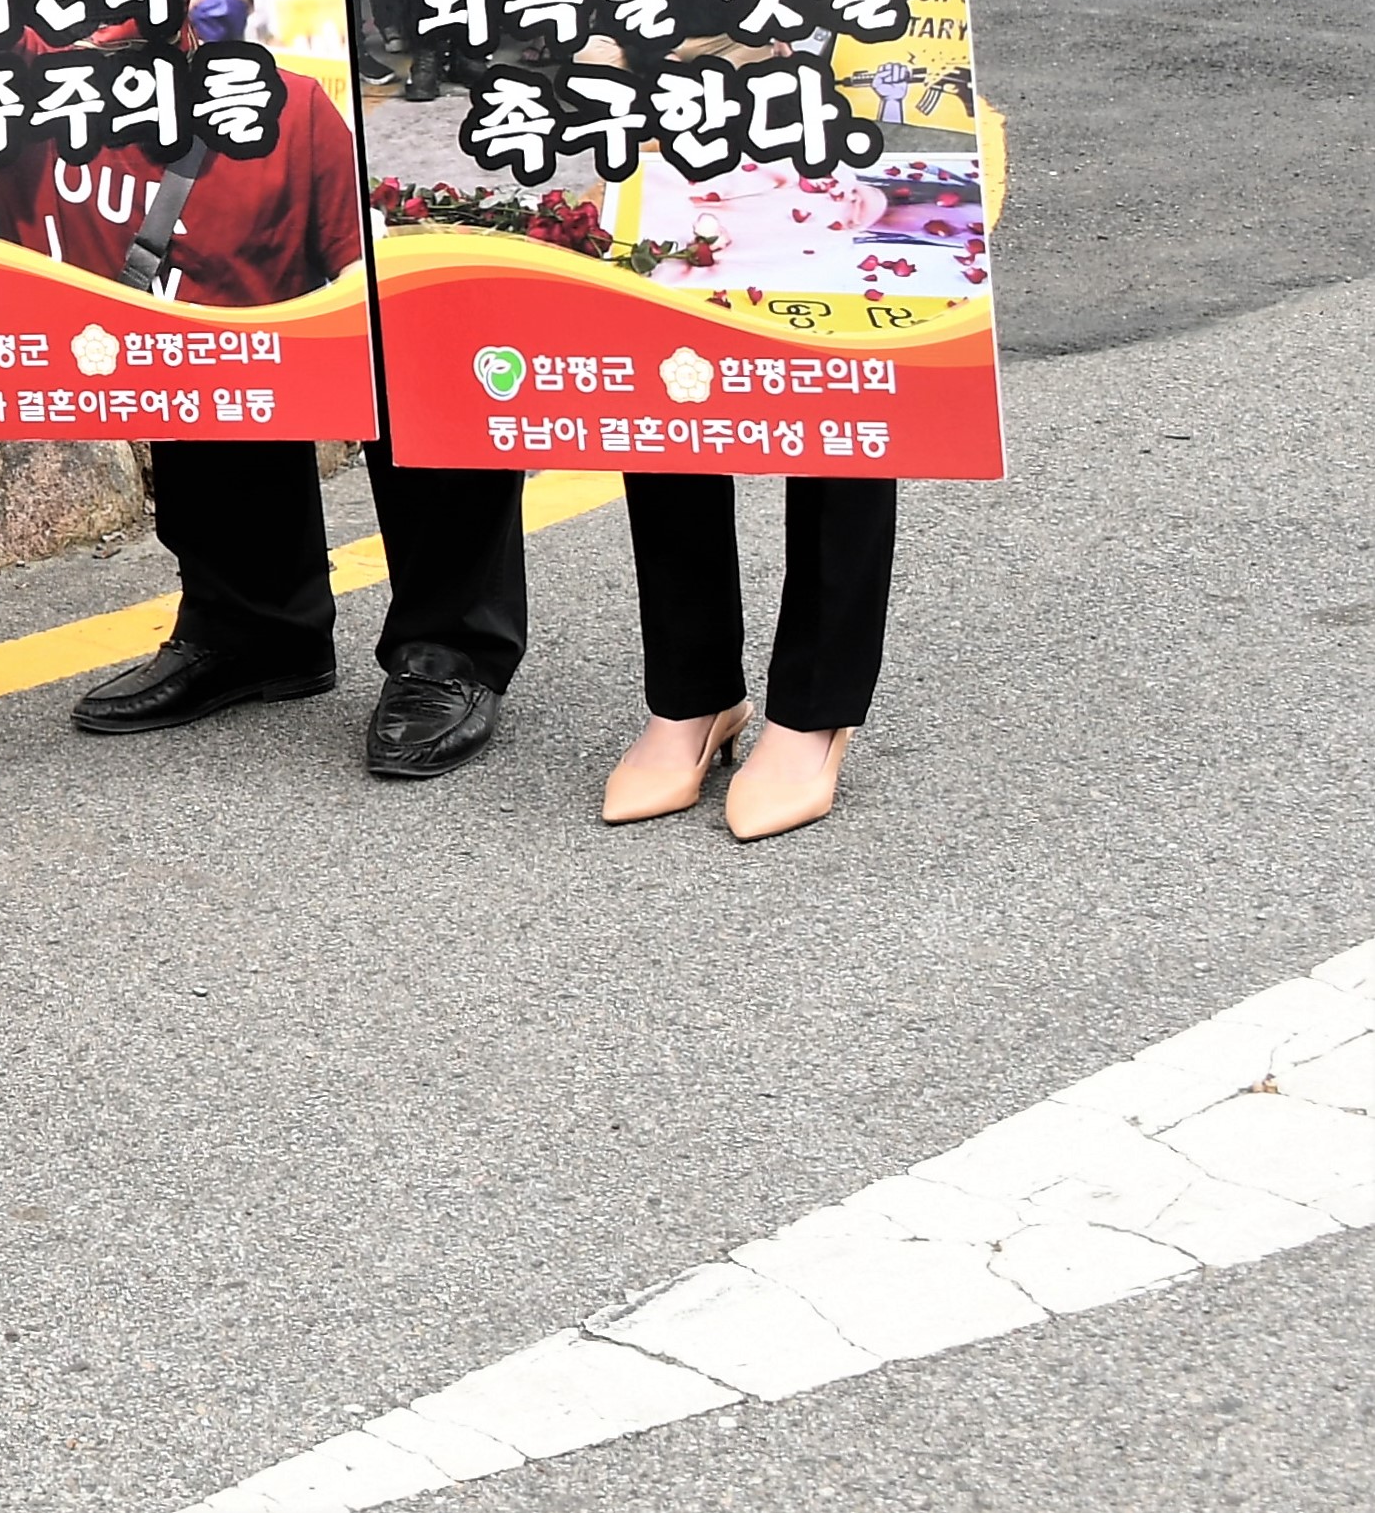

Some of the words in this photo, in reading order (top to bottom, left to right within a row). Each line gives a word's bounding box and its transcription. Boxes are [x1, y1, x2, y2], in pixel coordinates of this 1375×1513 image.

[471, 67, 872, 175] 촉구한다.
[123, 328, 282, 366] 함평군의회
[532, 354, 634, 395] 함평군
[718, 352, 898, 395] 함평군의회
[17, 389, 203, 425] 결혼이주여성
[213, 387, 276, 424] 일동
[488, 416, 587, 452] 동남아
[599, 417, 806, 454] 결혼이주여성
[818, 418, 890, 458] 일동
